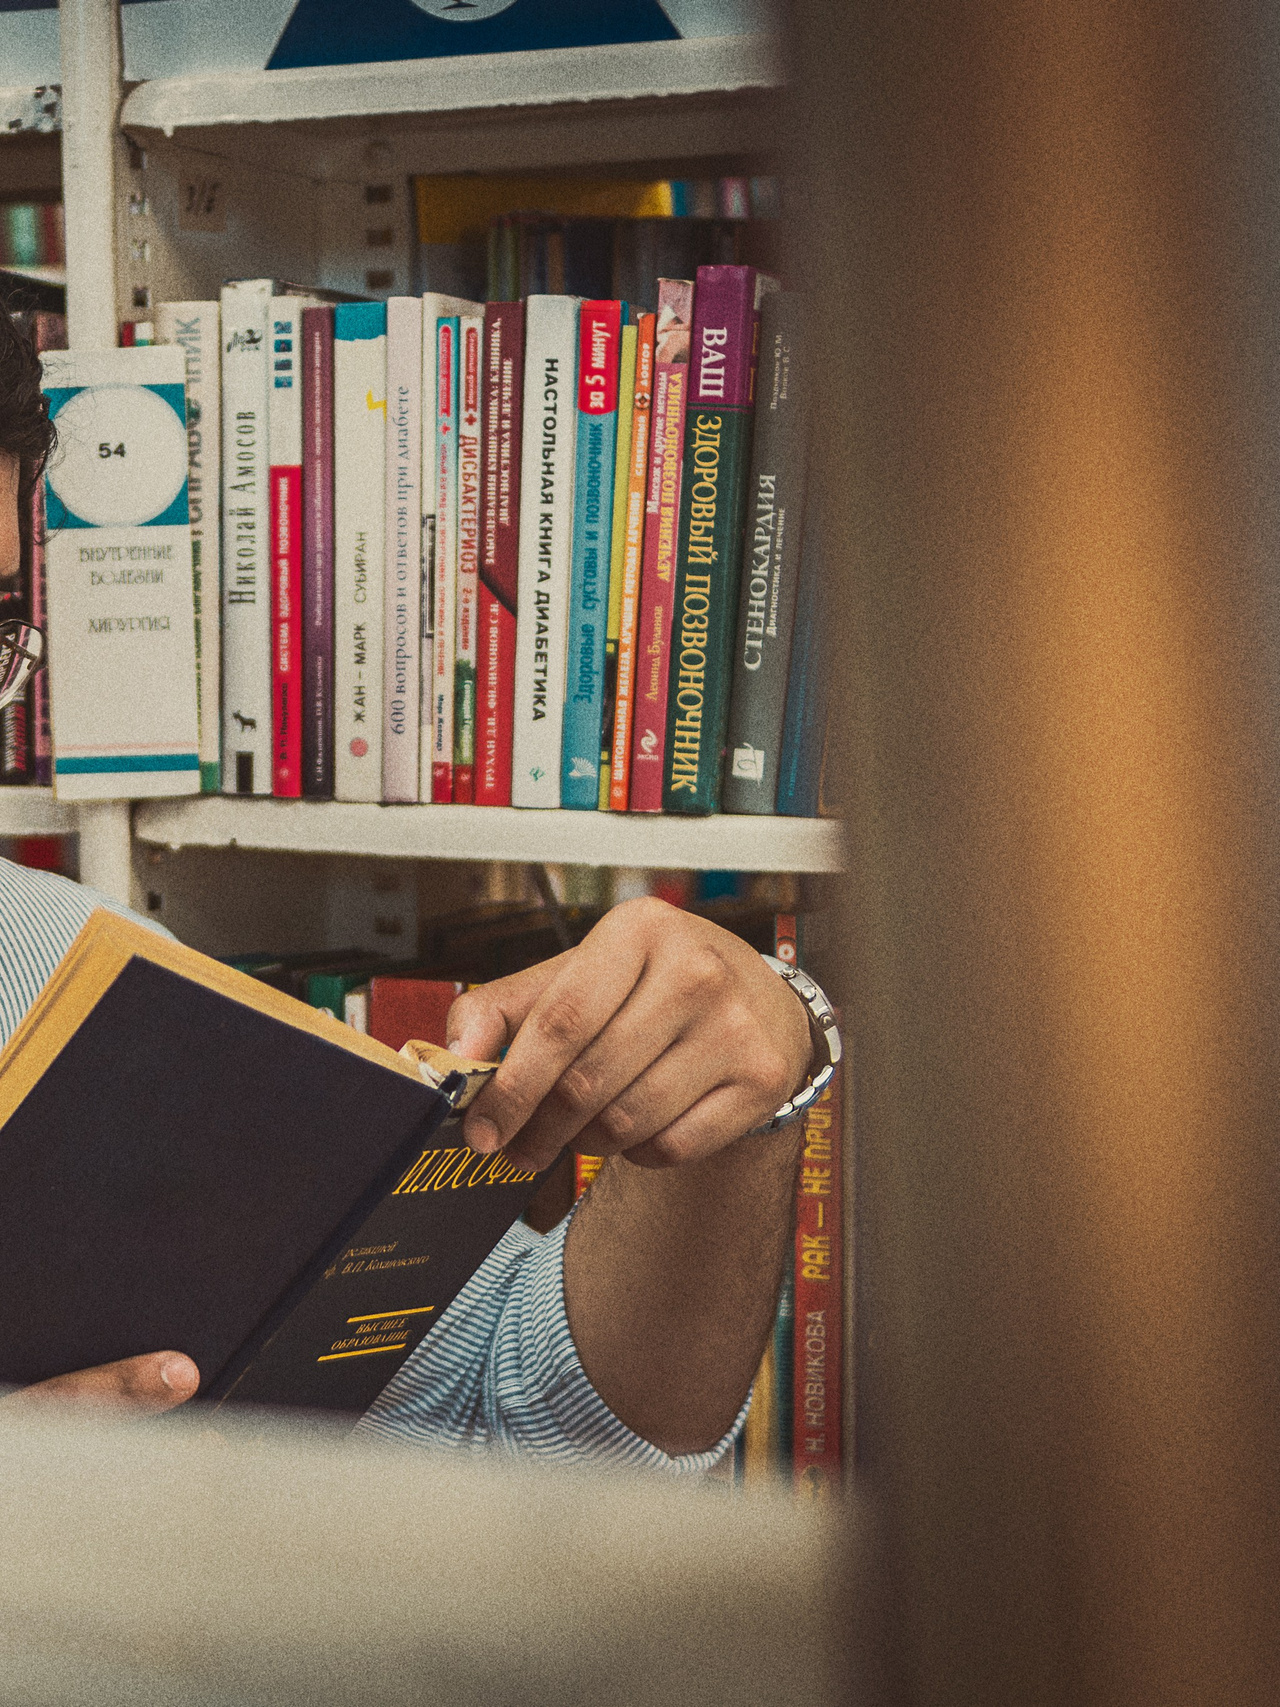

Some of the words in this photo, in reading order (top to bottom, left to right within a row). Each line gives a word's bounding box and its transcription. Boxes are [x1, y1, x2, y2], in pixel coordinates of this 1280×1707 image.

[489, 317, 501, 384] КЛИНИКА,
[591, 319, 611, 369] минут
[639, 342, 651, 387] ДОКТОР
[698, 326, 728, 399] ВАШ
[501, 357, 513, 418] ЛЕЧЕНИЕ
[584, 374, 605, 387] 5
[589, 391, 604, 408] за
[656, 371, 668, 414] методы
[393, 385, 410, 461] диабете
[487, 385, 499, 472] КИШЕЧНИКА:
[501, 420, 511, 430] И
[540, 358, 559, 505] НАСТОЛЬНАЯ
[634, 415, 647, 477] СЕМЕЙНЫЙ
[654, 416, 667, 455] другие
[661, 372, 683, 504] ПОЗВОНОЧНИКА
[97, 441, 127, 459] 54
[228, 410, 257, 495] Амосов
[585, 422, 603, 524] позвоночник
[397, 465, 414, 501] при
[459, 434, 478, 574] ДИСБАКТЕРИОЗ
[499, 431, 511, 527] ДИАГНОСТИКА
[646, 466, 661, 514] Массаж
[687, 414, 723, 565] ЗДОРОВЫЙ
[278, 475, 290, 555] ПОЗВОНОЧНИК
[485, 474, 497, 565] ЗАБОЛЕВАНИЯ
[586, 530, 597, 541] и
[628, 491, 640, 544] ЛЕЧЕНИЯ
[79, 545, 173, 563] ВНУТРЕННИЕ
[228, 506, 257, 605] Николай
[353, 531, 368, 604] СУБИРАН
[396, 507, 409, 582] ответов
[537, 512, 554, 584] КНИГА
[624, 546, 637, 595] МЕТОДЫ
[657, 506, 674, 583] ЛЕЧЕНИЯ
[90, 569, 165, 586] БОЛЕЗНИ
[278, 557, 290, 619] ЗДОРОВЫЙ
[397, 586, 408, 598] и
[462, 587, 472, 605] 2-е
[581, 547, 601, 611] суставы
[743, 473, 777, 671] СТЕНОКАРДИЯ
[87, 615, 171, 634] ХИРУРГИЯ
[279, 621, 291, 672] СИСТЕМА
[353, 622, 367, 665] МАРК
[460, 606, 471, 651] издание
[621, 597, 634, 645] ЛУЧШИЕ
[647, 605, 664, 656] Буланов
[393, 602, 412, 695] вопросов
[487, 625, 499, 709] ФИЛИМОНОВ
[532, 589, 551, 722] ДИАБЕТИКА
[572, 623, 599, 703] Здоровые
[353, 685, 367, 724] ЖАН
[645, 656, 661, 702] Леонид
[670, 572, 712, 795] ПОЗВОНОЧНИК
[390, 698, 407, 736] 600
[613, 699, 627, 781] ЩИТОВИДНАЯ
[485, 740, 496, 789] ТРУХАН
[802, 1166, 832, 1196] НЕ
[801, 1234, 831, 1281] РАК
[331, 1329, 413, 1351] ОБРАЗОВАНИЕ
[355, 1317, 409, 1335] ВЫСШЕЕ
[804, 1309, 826, 1427] НОВИКОВА
[804, 1433, 825, 1454] Н.
